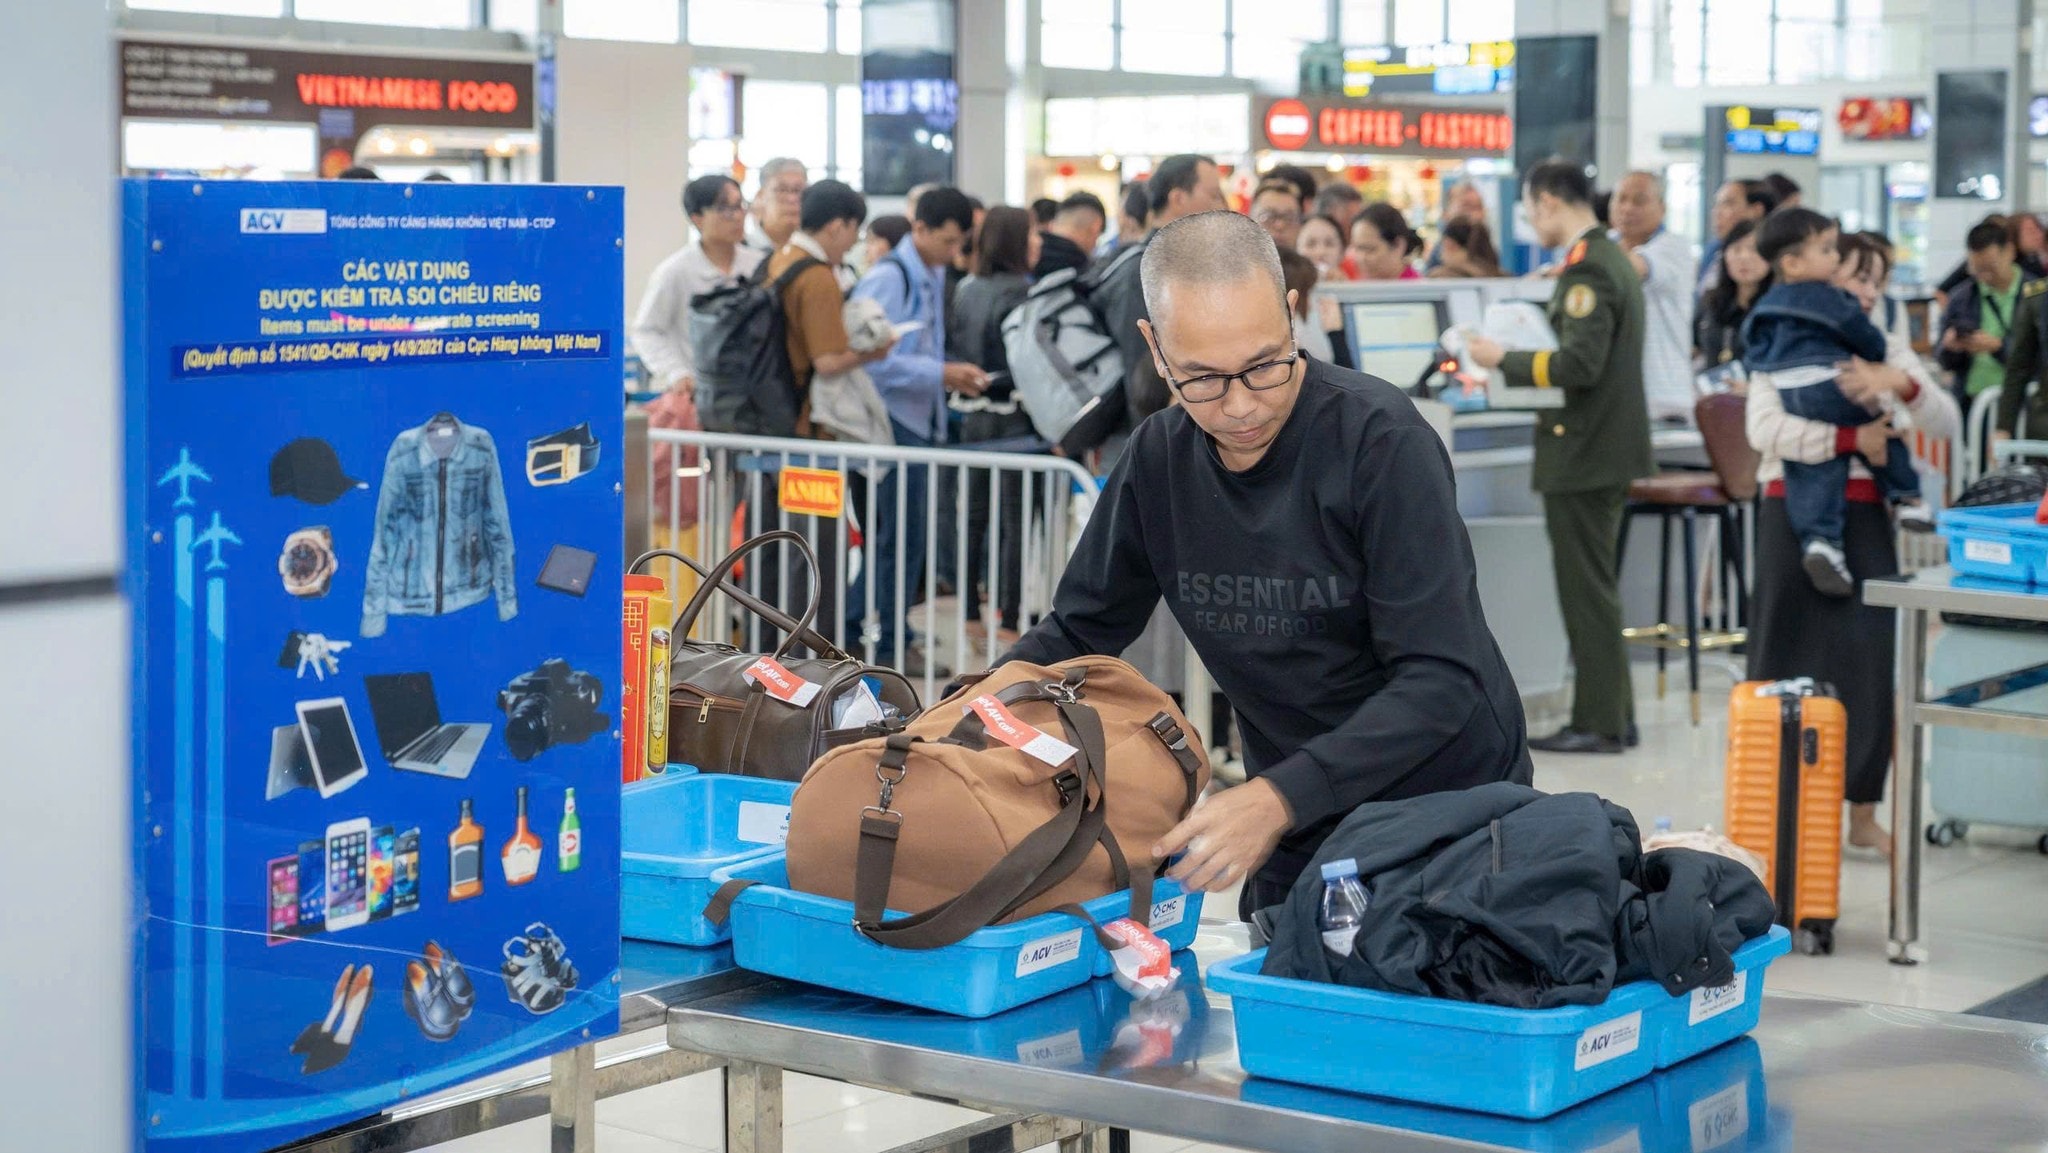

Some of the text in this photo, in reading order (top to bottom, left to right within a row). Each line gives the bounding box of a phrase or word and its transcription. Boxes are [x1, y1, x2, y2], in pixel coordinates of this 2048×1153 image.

[296, 73, 443, 111] VIETNAMESE
[447, 79, 518, 113] FOOD
[247, 212, 285, 230] ACV
[387, 215, 400, 228] TY
[455, 214, 487, 229] KHÔNG
[488, 215, 507, 230] VIỆT
[508, 217, 528, 229] NAM
[533, 217, 555, 229] CTCP
[342, 257, 470, 285] CÁC VẬT DỤNG
[259, 288, 317, 313] ĐƯỢC
[368, 286, 404, 307] TRA
[406, 286, 436, 306] SOI
[439, 282, 489, 305] CHIẾU
[493, 280, 541, 303] RIÊNG
[260, 310, 540, 335] Items must be under separate screening
[229, 345, 259, 368] định
[259, 341, 277, 363] số
[279, 341, 360, 363] 1541/QĐ-CHK
[361, 340, 390, 362] ngày
[392, 338, 443, 357] 14/9/2021
[445, 337, 466, 354] của
[467, 337, 489, 356] Cục
[490, 335, 519, 355] Hàng
[520, 335, 552, 354] không
[554, 333, 574, 352] Việt
[575, 333, 601, 352] Nam)
[1177, 570, 1351, 611] ESSENTIAL
[1195, 610, 1328, 638] FEAR OF GOD
[1161, 900, 1177, 914] CMC
[1031, 945, 1052, 962] ACV
[1590, 1032, 1611, 1053] ACV
